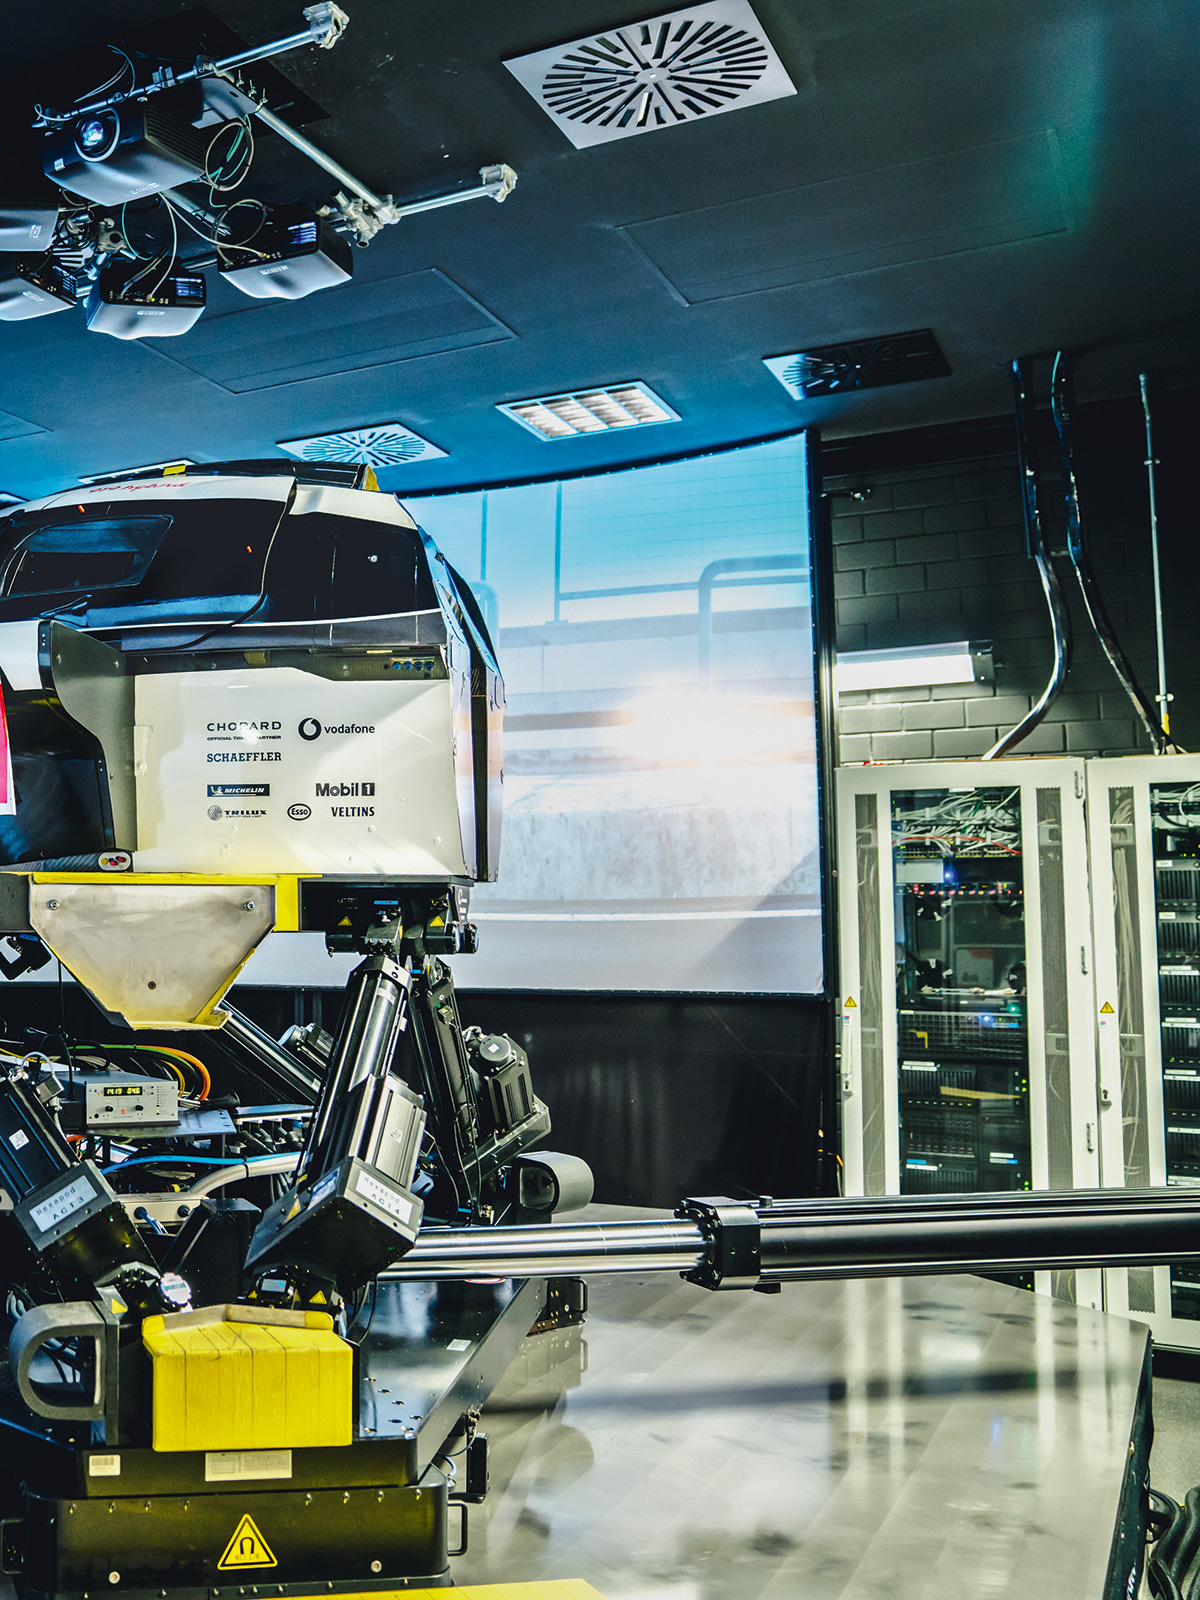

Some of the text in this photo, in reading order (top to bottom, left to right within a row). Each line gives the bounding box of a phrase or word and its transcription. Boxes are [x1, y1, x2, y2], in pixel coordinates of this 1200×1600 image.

[324, 724, 375, 734] vodafone
[206, 752, 282, 763] SCHAEFFLER
[315, 782, 359, 797] Mobil
[331, 806, 375, 817] VELTINS
[36, 1186, 76, 1216] Hexapod
